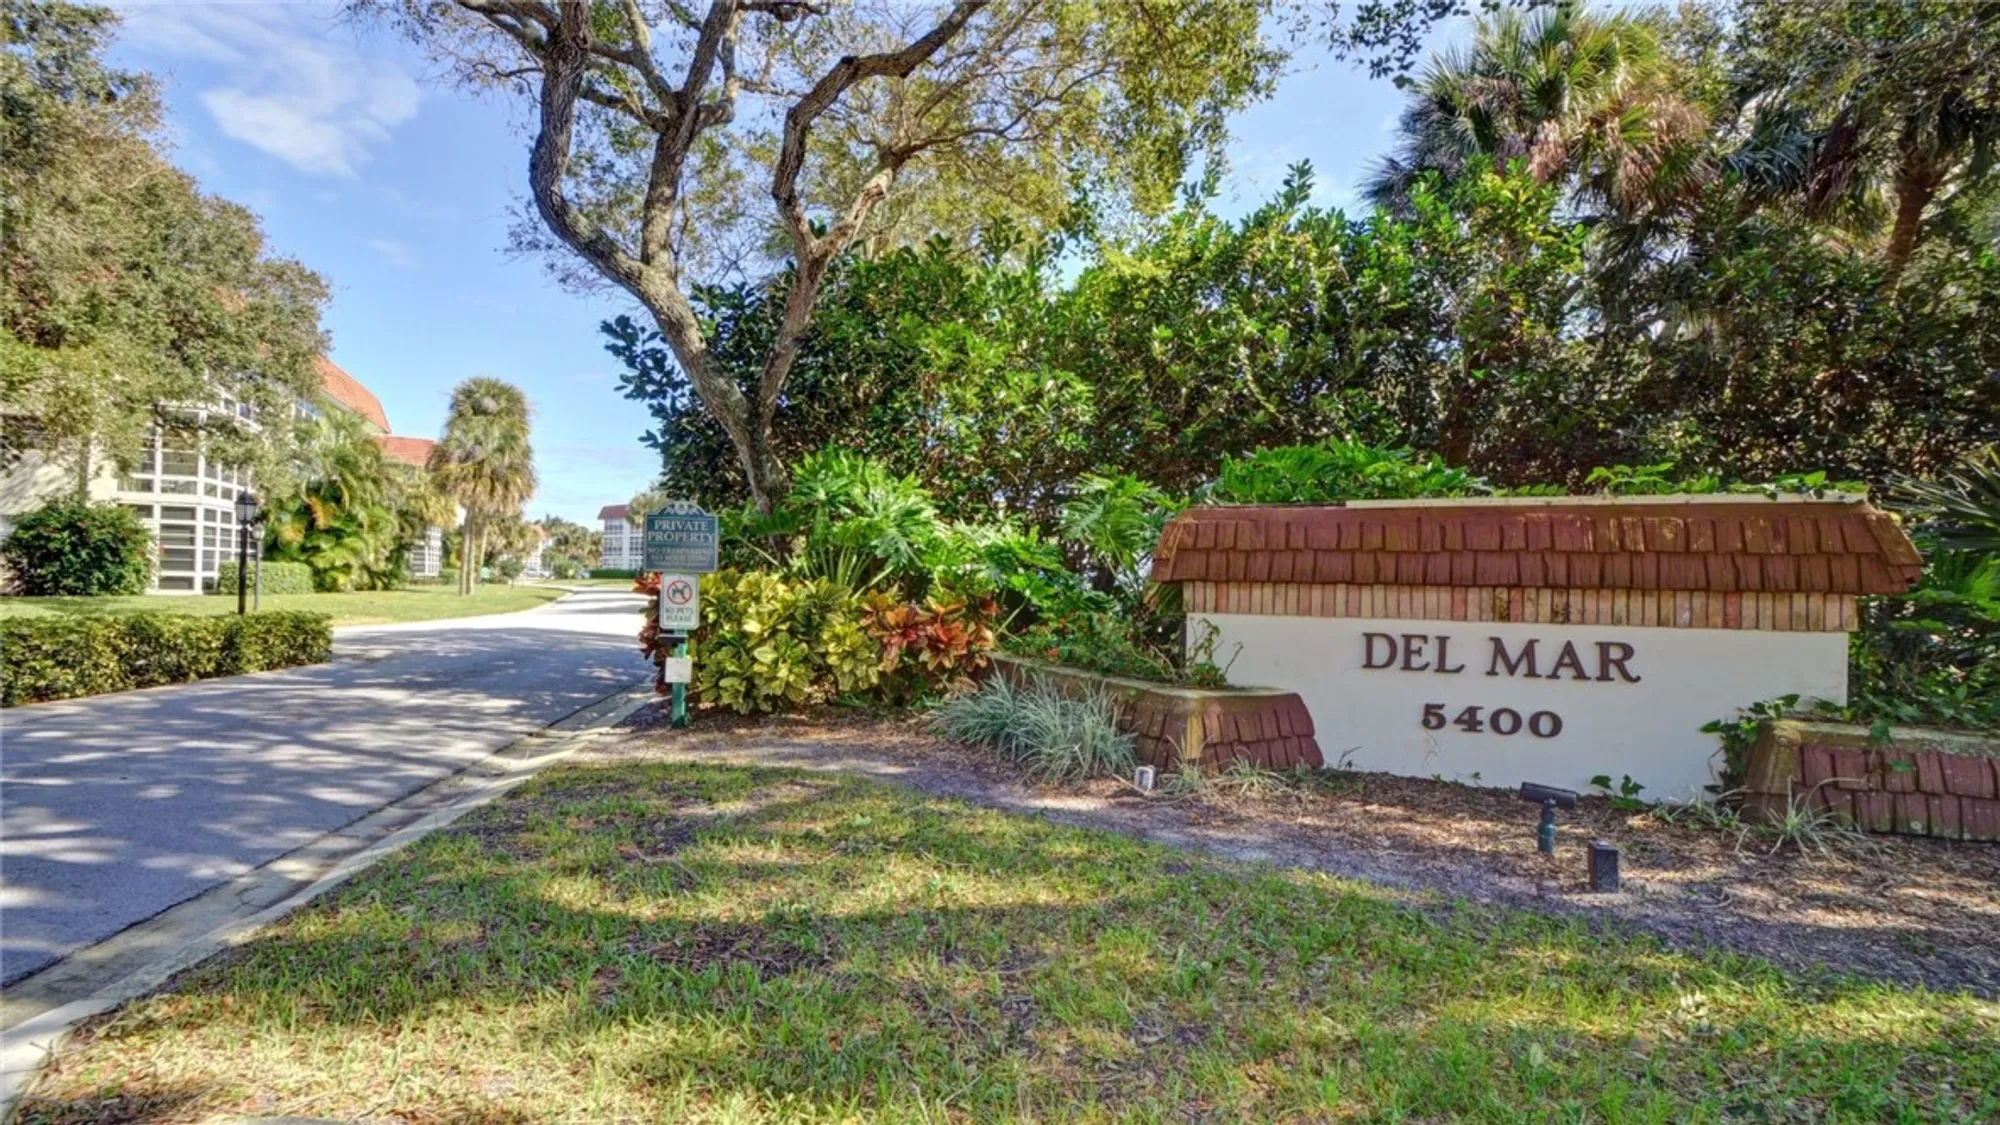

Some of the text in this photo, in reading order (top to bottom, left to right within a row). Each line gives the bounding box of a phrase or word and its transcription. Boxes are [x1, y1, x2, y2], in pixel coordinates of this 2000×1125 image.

[654, 519, 708, 531] PRIVATE
[648, 531, 713, 543] PROPERTY
[676, 607, 693, 615] PETS
[666, 614, 692, 622] PLEASE
[1361, 632, 1642, 684] DEL MAR
[1421, 702, 1563, 738] 5400
